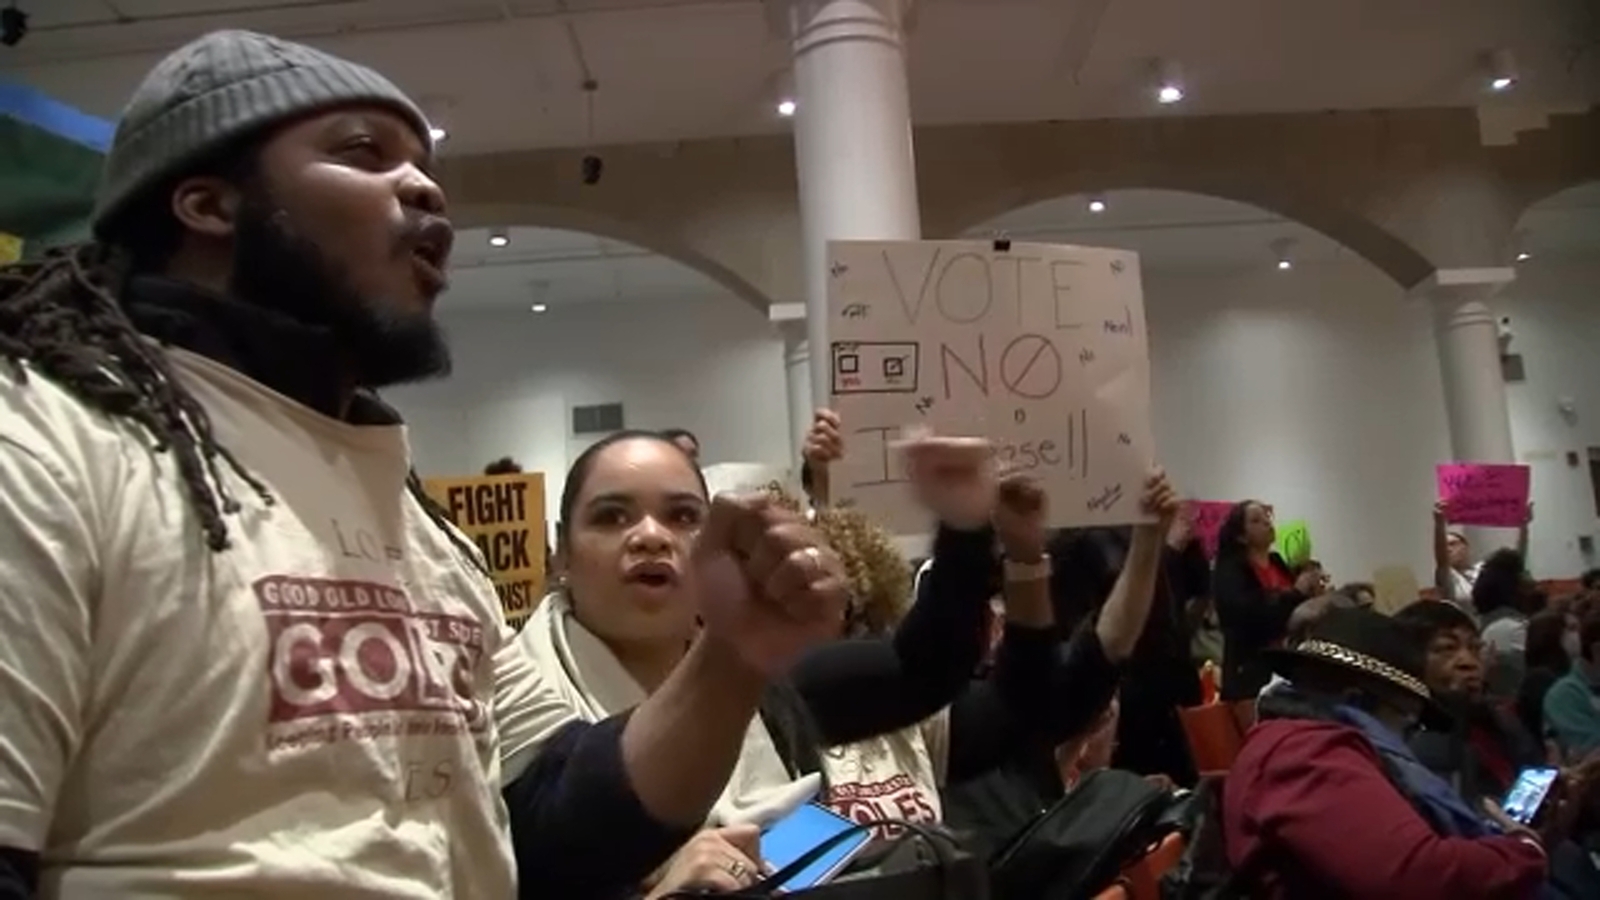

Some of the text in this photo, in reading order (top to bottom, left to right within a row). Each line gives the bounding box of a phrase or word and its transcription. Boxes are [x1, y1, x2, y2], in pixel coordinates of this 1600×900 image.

[881, 247, 1087, 329] VOTE
[447, 481, 529, 526] FIGHT
[474, 529, 532, 572] ACK
[838, 792, 937, 840] OLES
